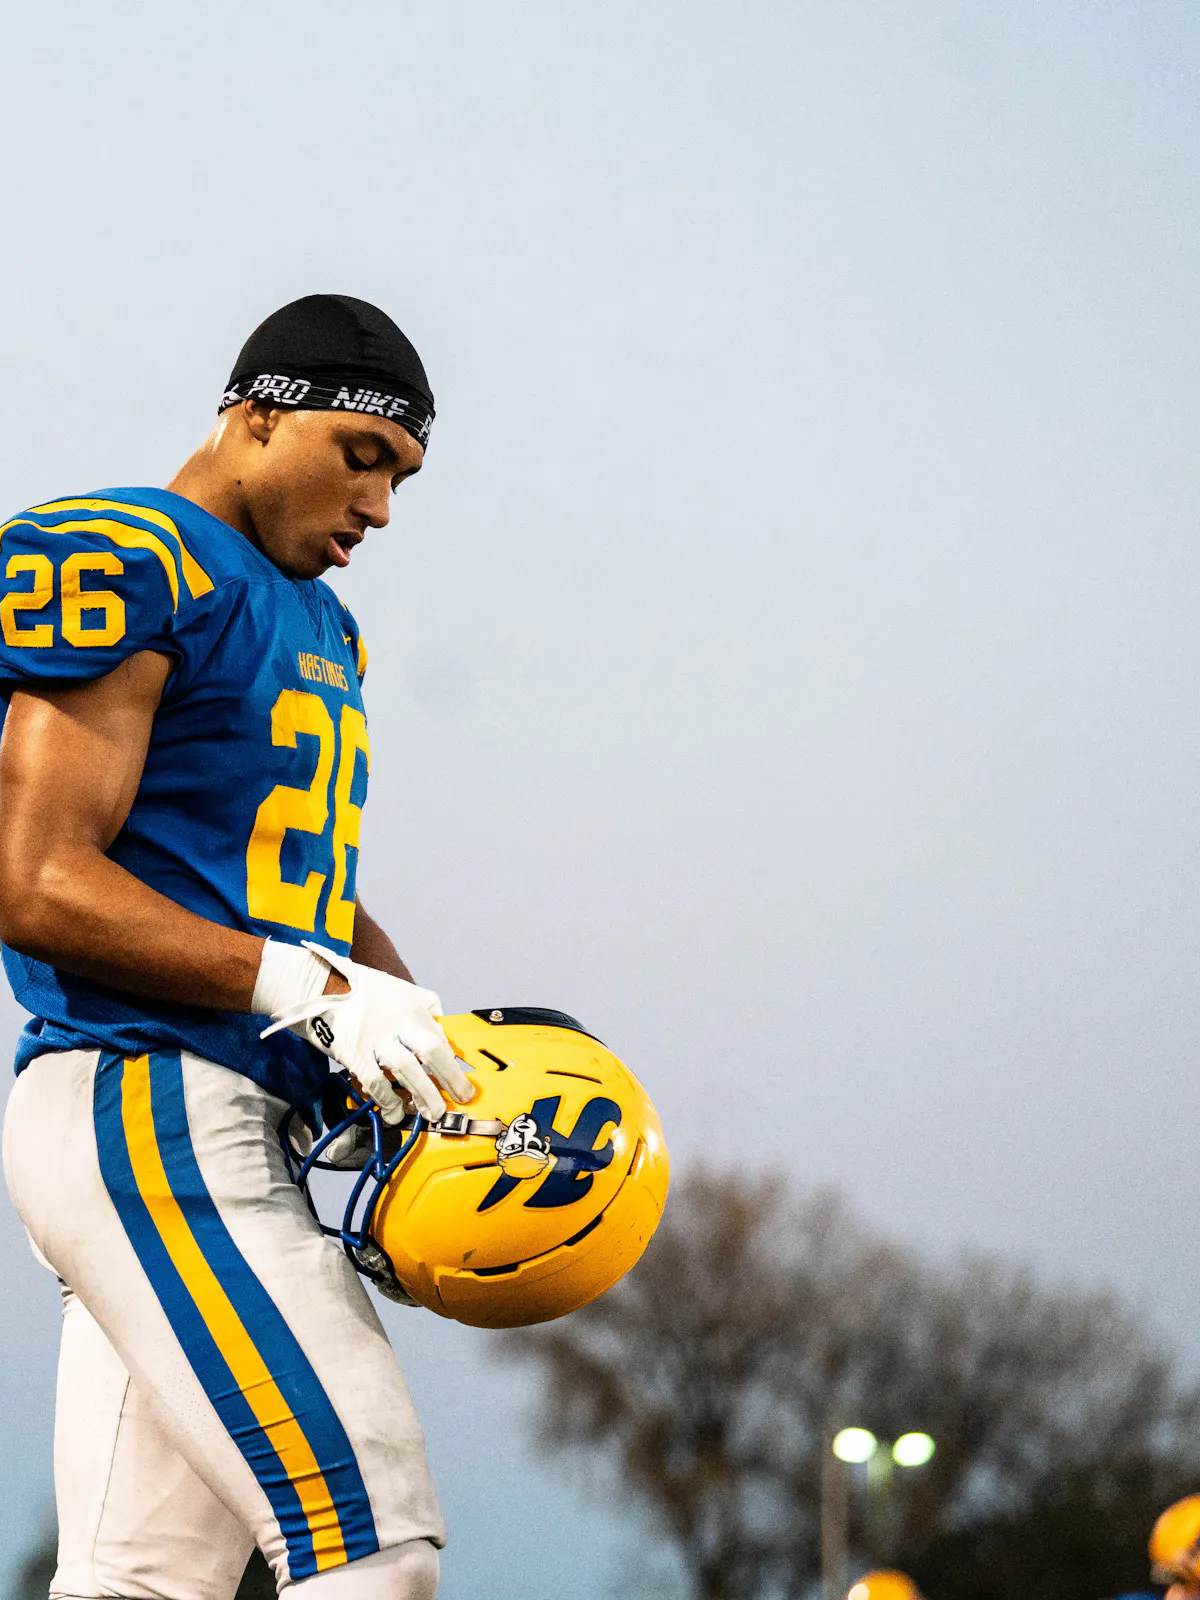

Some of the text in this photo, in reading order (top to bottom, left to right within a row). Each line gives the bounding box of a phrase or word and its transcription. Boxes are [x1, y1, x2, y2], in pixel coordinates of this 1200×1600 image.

[247, 374, 311, 405] PRO
[331, 386, 410, 418] NIKE
[0, 552, 126, 648] 26
[298, 651, 349, 692] HASTINGS
